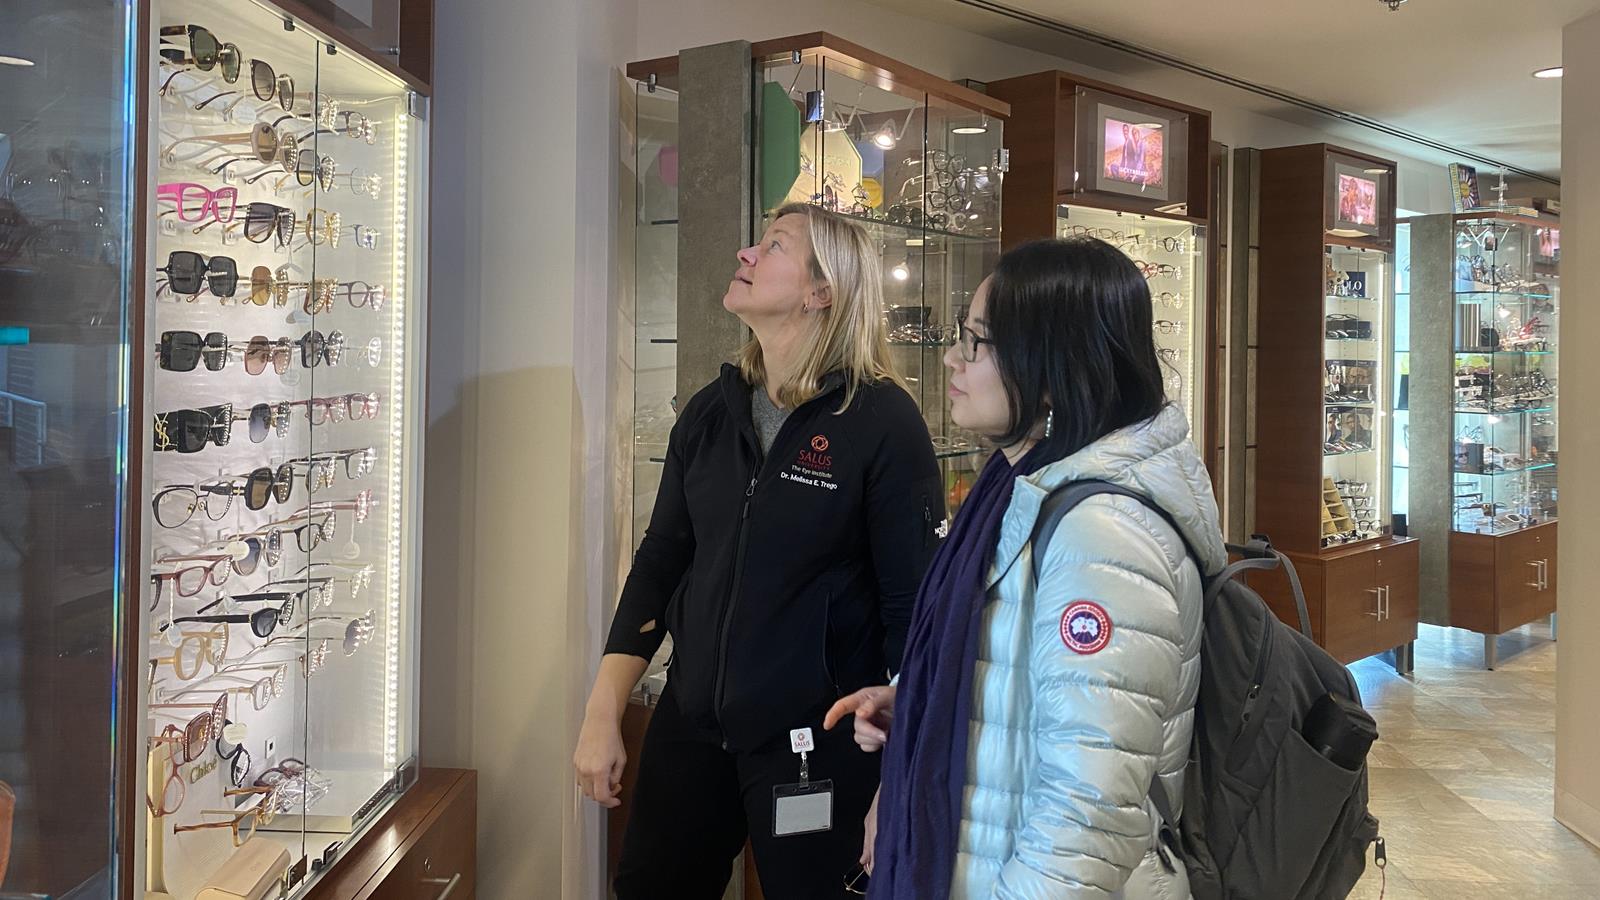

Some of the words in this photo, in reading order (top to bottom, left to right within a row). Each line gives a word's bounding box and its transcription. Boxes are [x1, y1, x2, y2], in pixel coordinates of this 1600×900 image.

[798, 449, 833, 466] SALUS
[791, 464, 802, 473] The
[801, 467, 812, 475] Eye
[811, 470, 833, 479] Institute
[780, 471, 790, 480] Dr.
[790, 473, 813, 485] Melissa
[820, 480, 838, 491] Trego
[189, 753, 217, 784] Chloé
